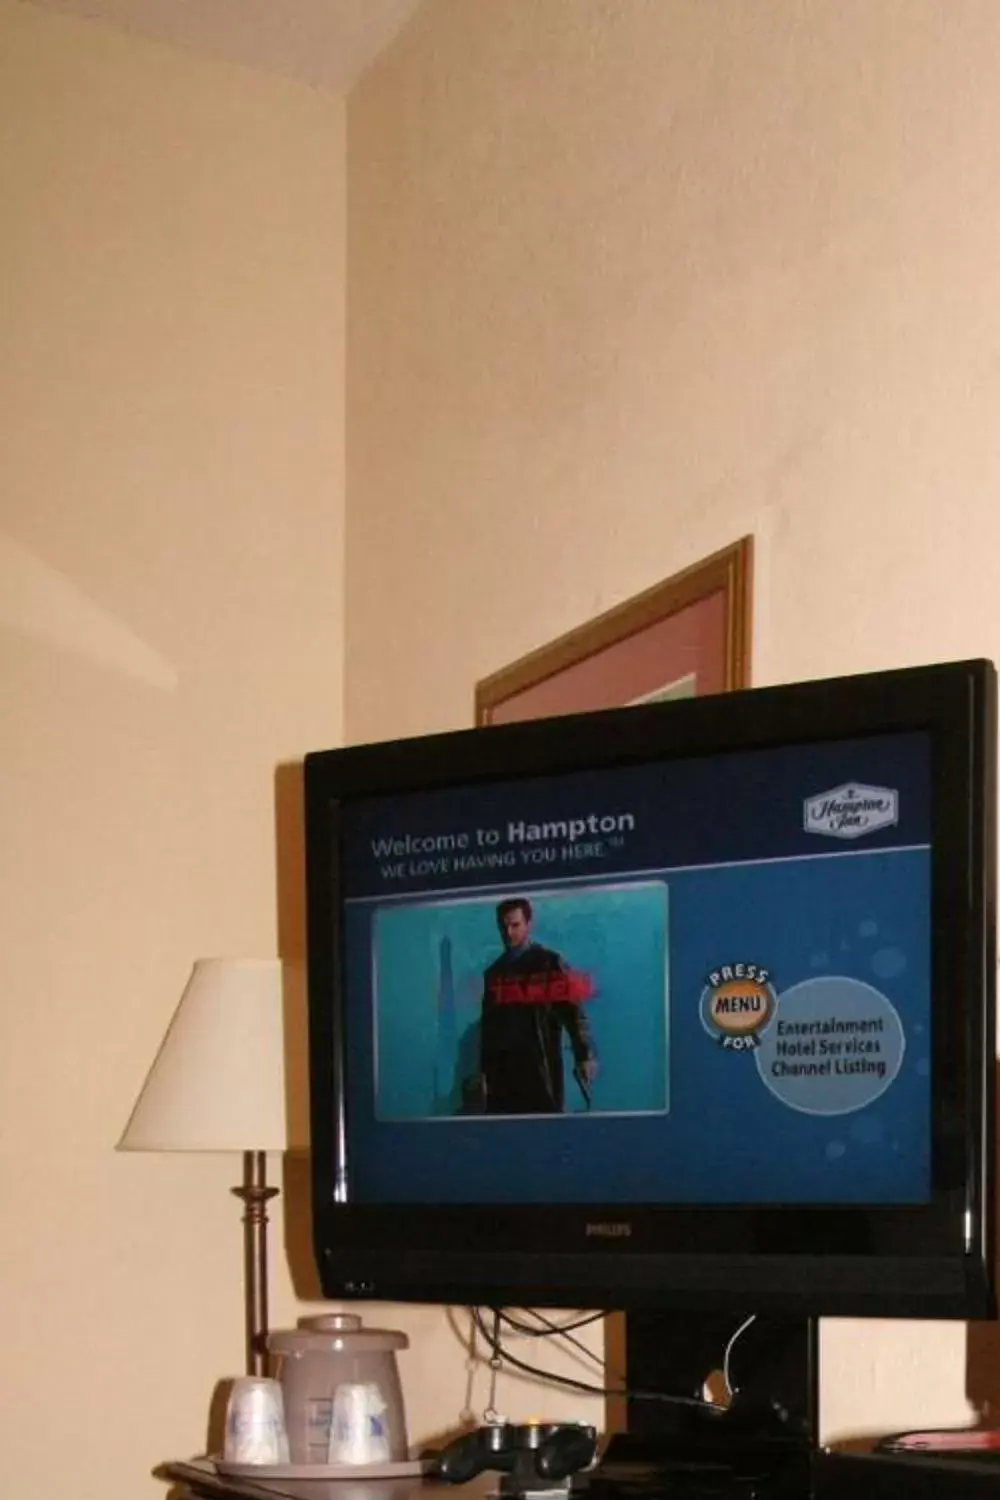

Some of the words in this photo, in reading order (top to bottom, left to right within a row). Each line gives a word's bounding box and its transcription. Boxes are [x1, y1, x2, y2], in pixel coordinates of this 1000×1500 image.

[371, 832, 470, 858] Welcome
[476, 828, 500, 847] to
[507, 812, 635, 843] Hampton
[380, 862, 407, 879] WE
[409, 856, 448, 876] LOVE
[453, 850, 516, 872] HAVING
[520, 847, 556, 864] YOU
[709, 963, 769, 986] PRESS
[715, 996, 761, 1013] MENU
[777, 1017, 884, 1036] Entertainment
[722, 1035, 757, 1050] FOR
[776, 1040, 816, 1057] Hotel
[820, 1037, 881, 1056] Services
[771, 1059, 831, 1077] Channel
[835, 1058, 887, 1080] Listing
